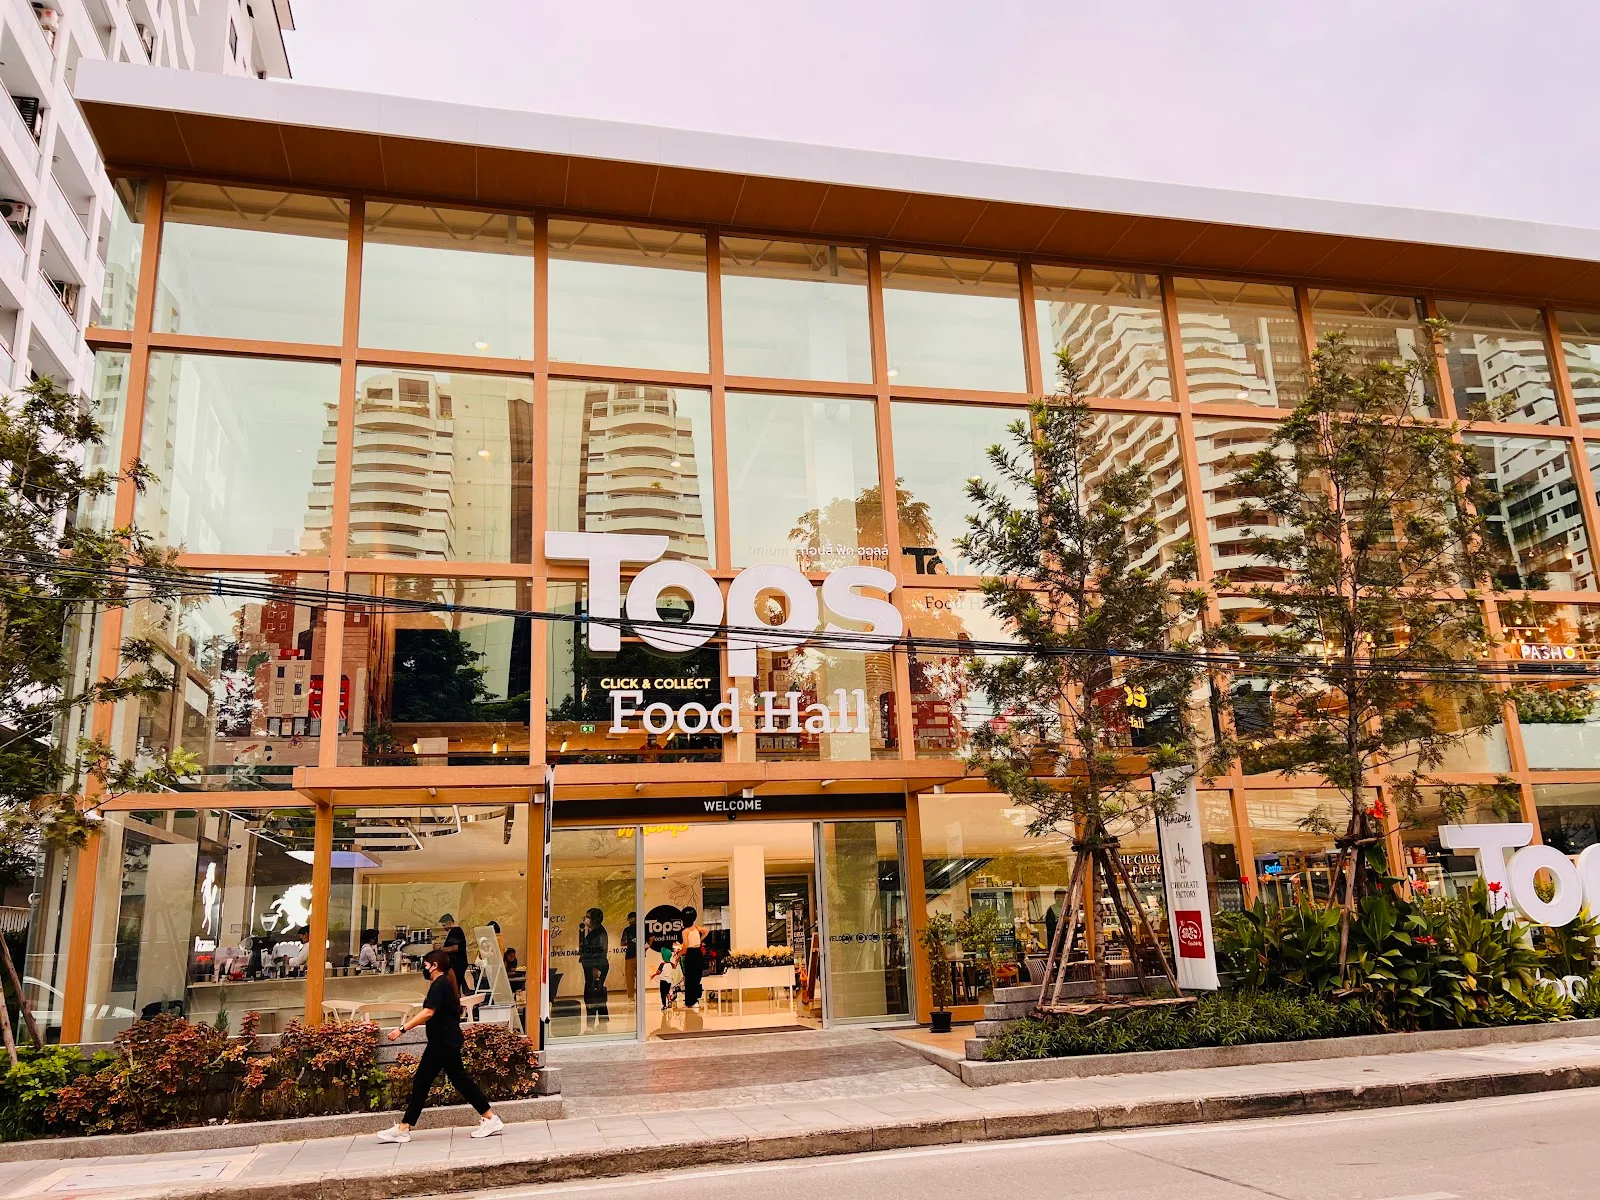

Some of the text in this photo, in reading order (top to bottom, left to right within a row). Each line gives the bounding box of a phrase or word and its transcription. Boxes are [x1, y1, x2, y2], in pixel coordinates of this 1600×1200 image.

[545, 531, 903, 677] Tops
[600, 678, 711, 689] CLICK & COLLECT
[608, 688, 869, 734] Food Hall
[703, 799, 762, 812] WELCOME
[645, 919, 681, 935] Tops
